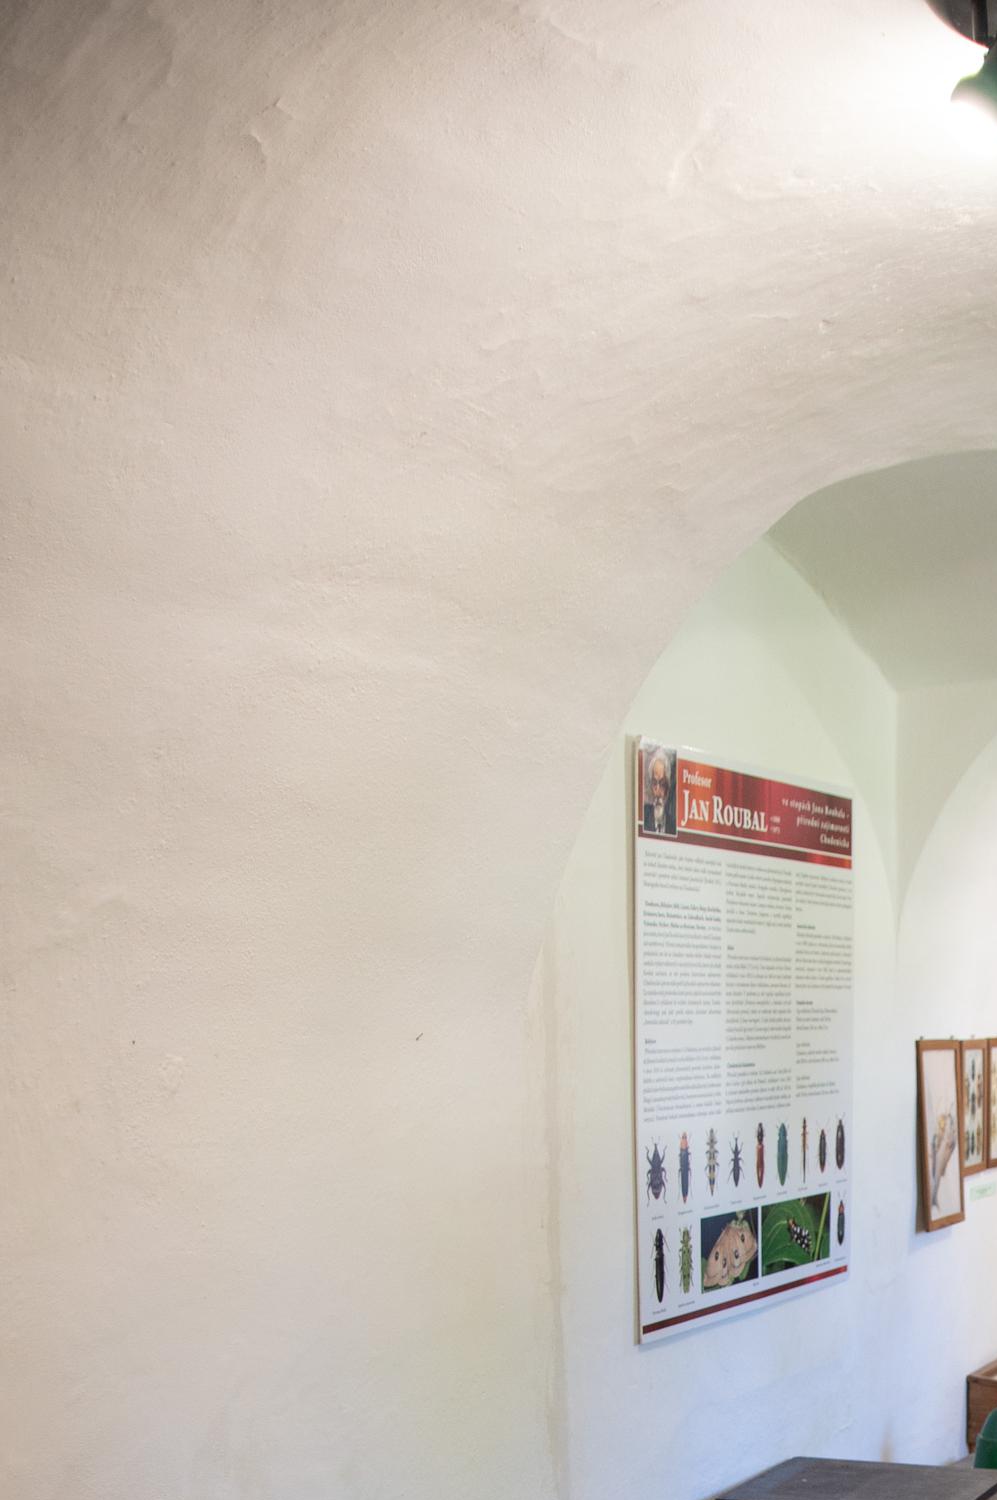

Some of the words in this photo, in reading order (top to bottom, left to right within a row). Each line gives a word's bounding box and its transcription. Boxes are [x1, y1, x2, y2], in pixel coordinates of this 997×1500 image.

[682, 768, 712, 789] Profesor
[681, 789, 710, 827] JAN
[712, 795, 769, 833] ROUBAL
[811, 802, 825, 815] Jana
[825, 806, 846, 820] Roubala
